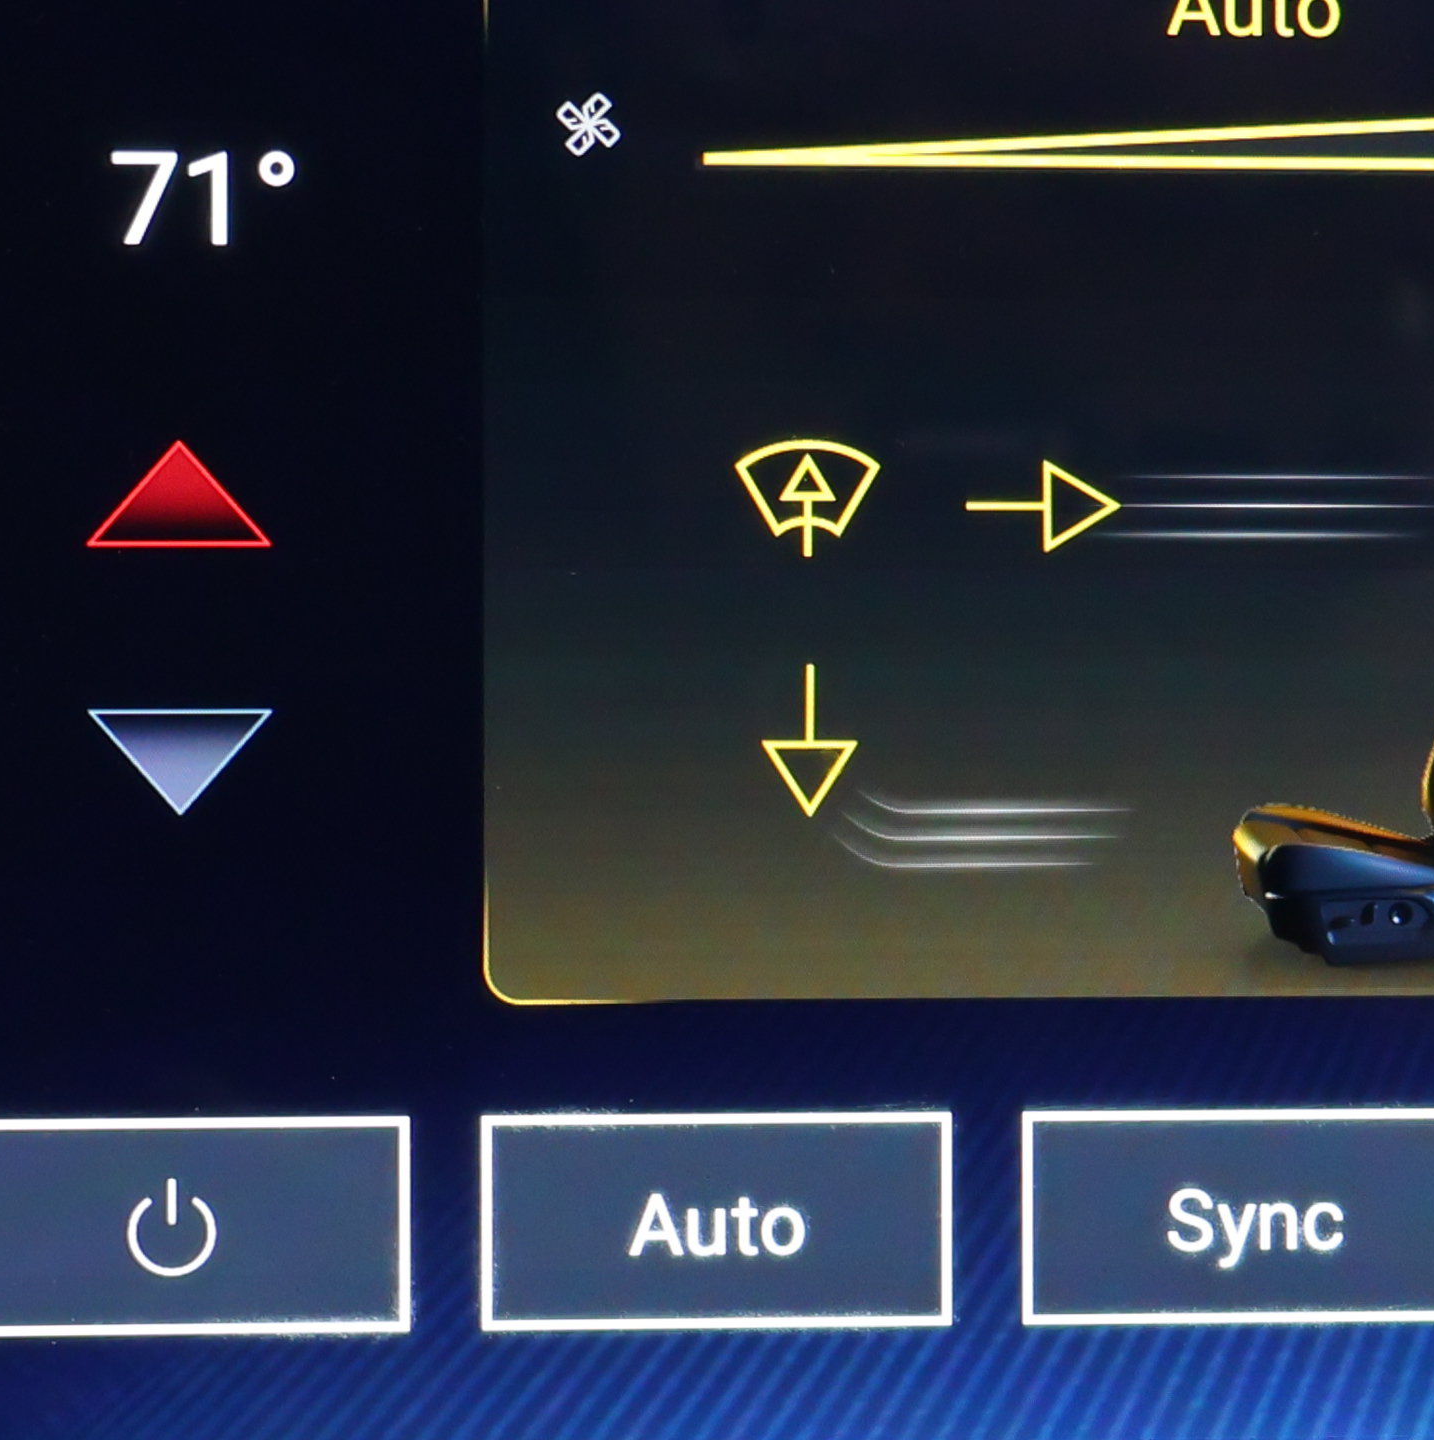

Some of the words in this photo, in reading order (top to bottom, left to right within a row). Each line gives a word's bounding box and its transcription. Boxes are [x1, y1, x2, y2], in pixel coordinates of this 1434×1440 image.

[109, 148, 297, 247] 71°
[627, 1192, 808, 1258] Auto
[1165, 1186, 1346, 1271] Sync
